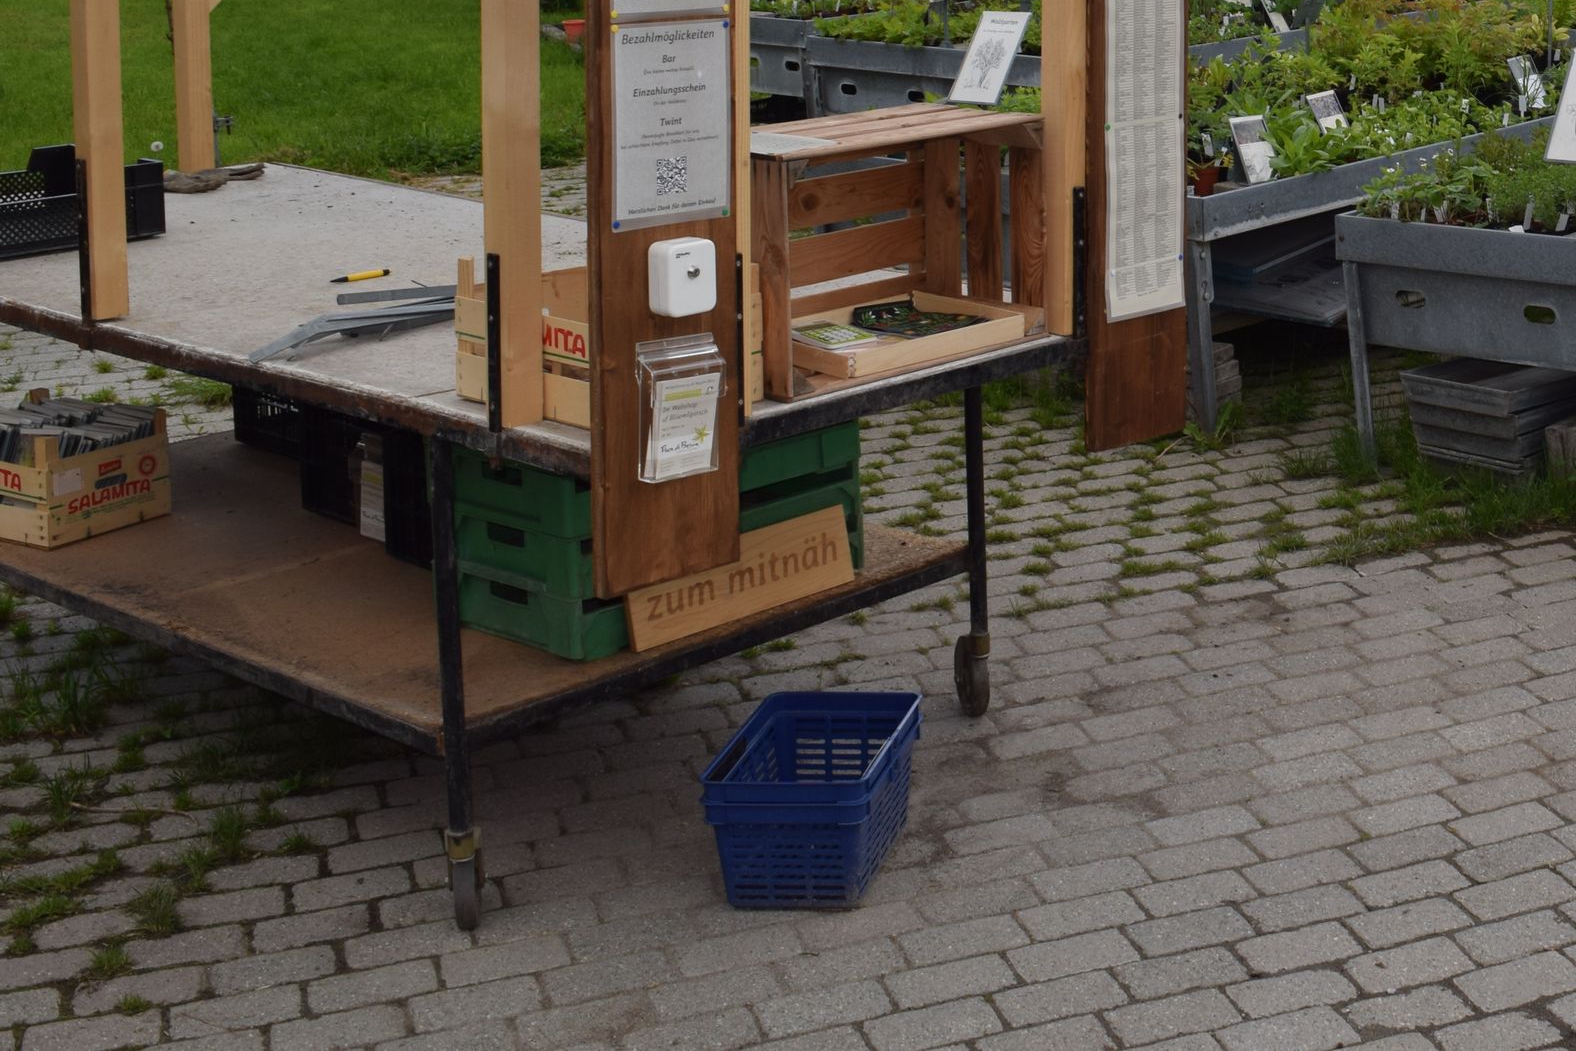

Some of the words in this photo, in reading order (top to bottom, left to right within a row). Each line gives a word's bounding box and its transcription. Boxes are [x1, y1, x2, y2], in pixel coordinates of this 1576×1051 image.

[662, 54, 676, 64] Bar
[633, 82, 706, 98] Einzahlungsschein
[659, 117, 683, 127] Twint
[67, 479, 151, 515] SALAMITA
[647, 578, 715, 622] zum
[728, 531, 838, 595] mitnäh
